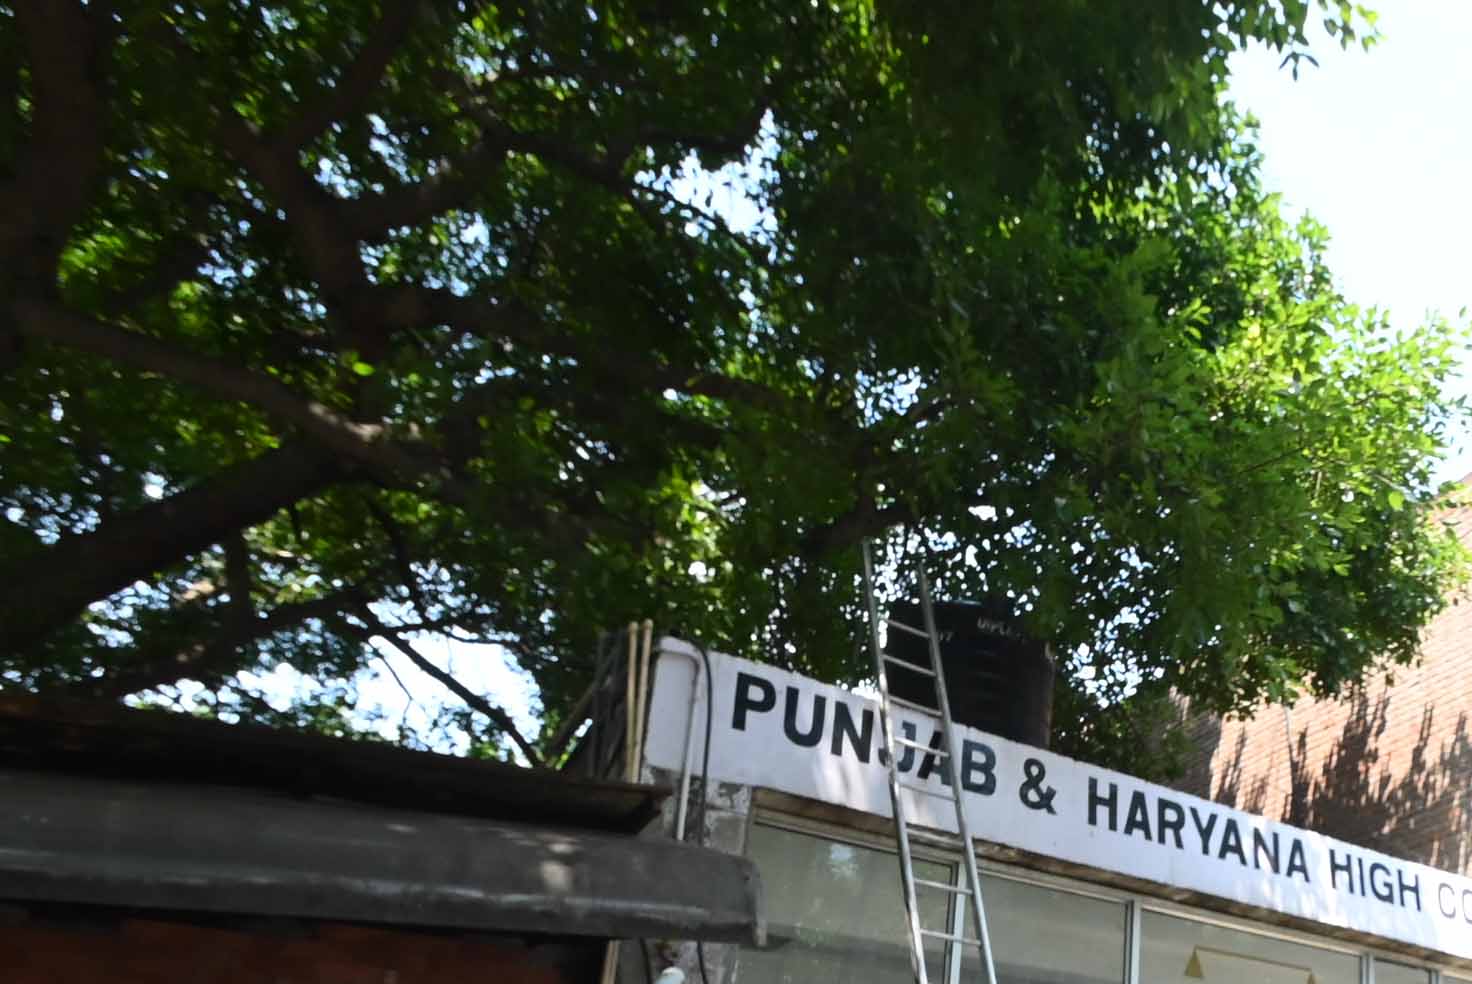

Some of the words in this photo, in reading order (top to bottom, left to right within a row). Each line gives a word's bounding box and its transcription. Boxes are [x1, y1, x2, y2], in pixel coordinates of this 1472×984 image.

[731, 672, 997, 796] PUNJAB
[1018, 757, 1057, 815] &
[1087, 776, 1311, 884] HARYANA
[1329, 847, 1423, 913] HIGH
